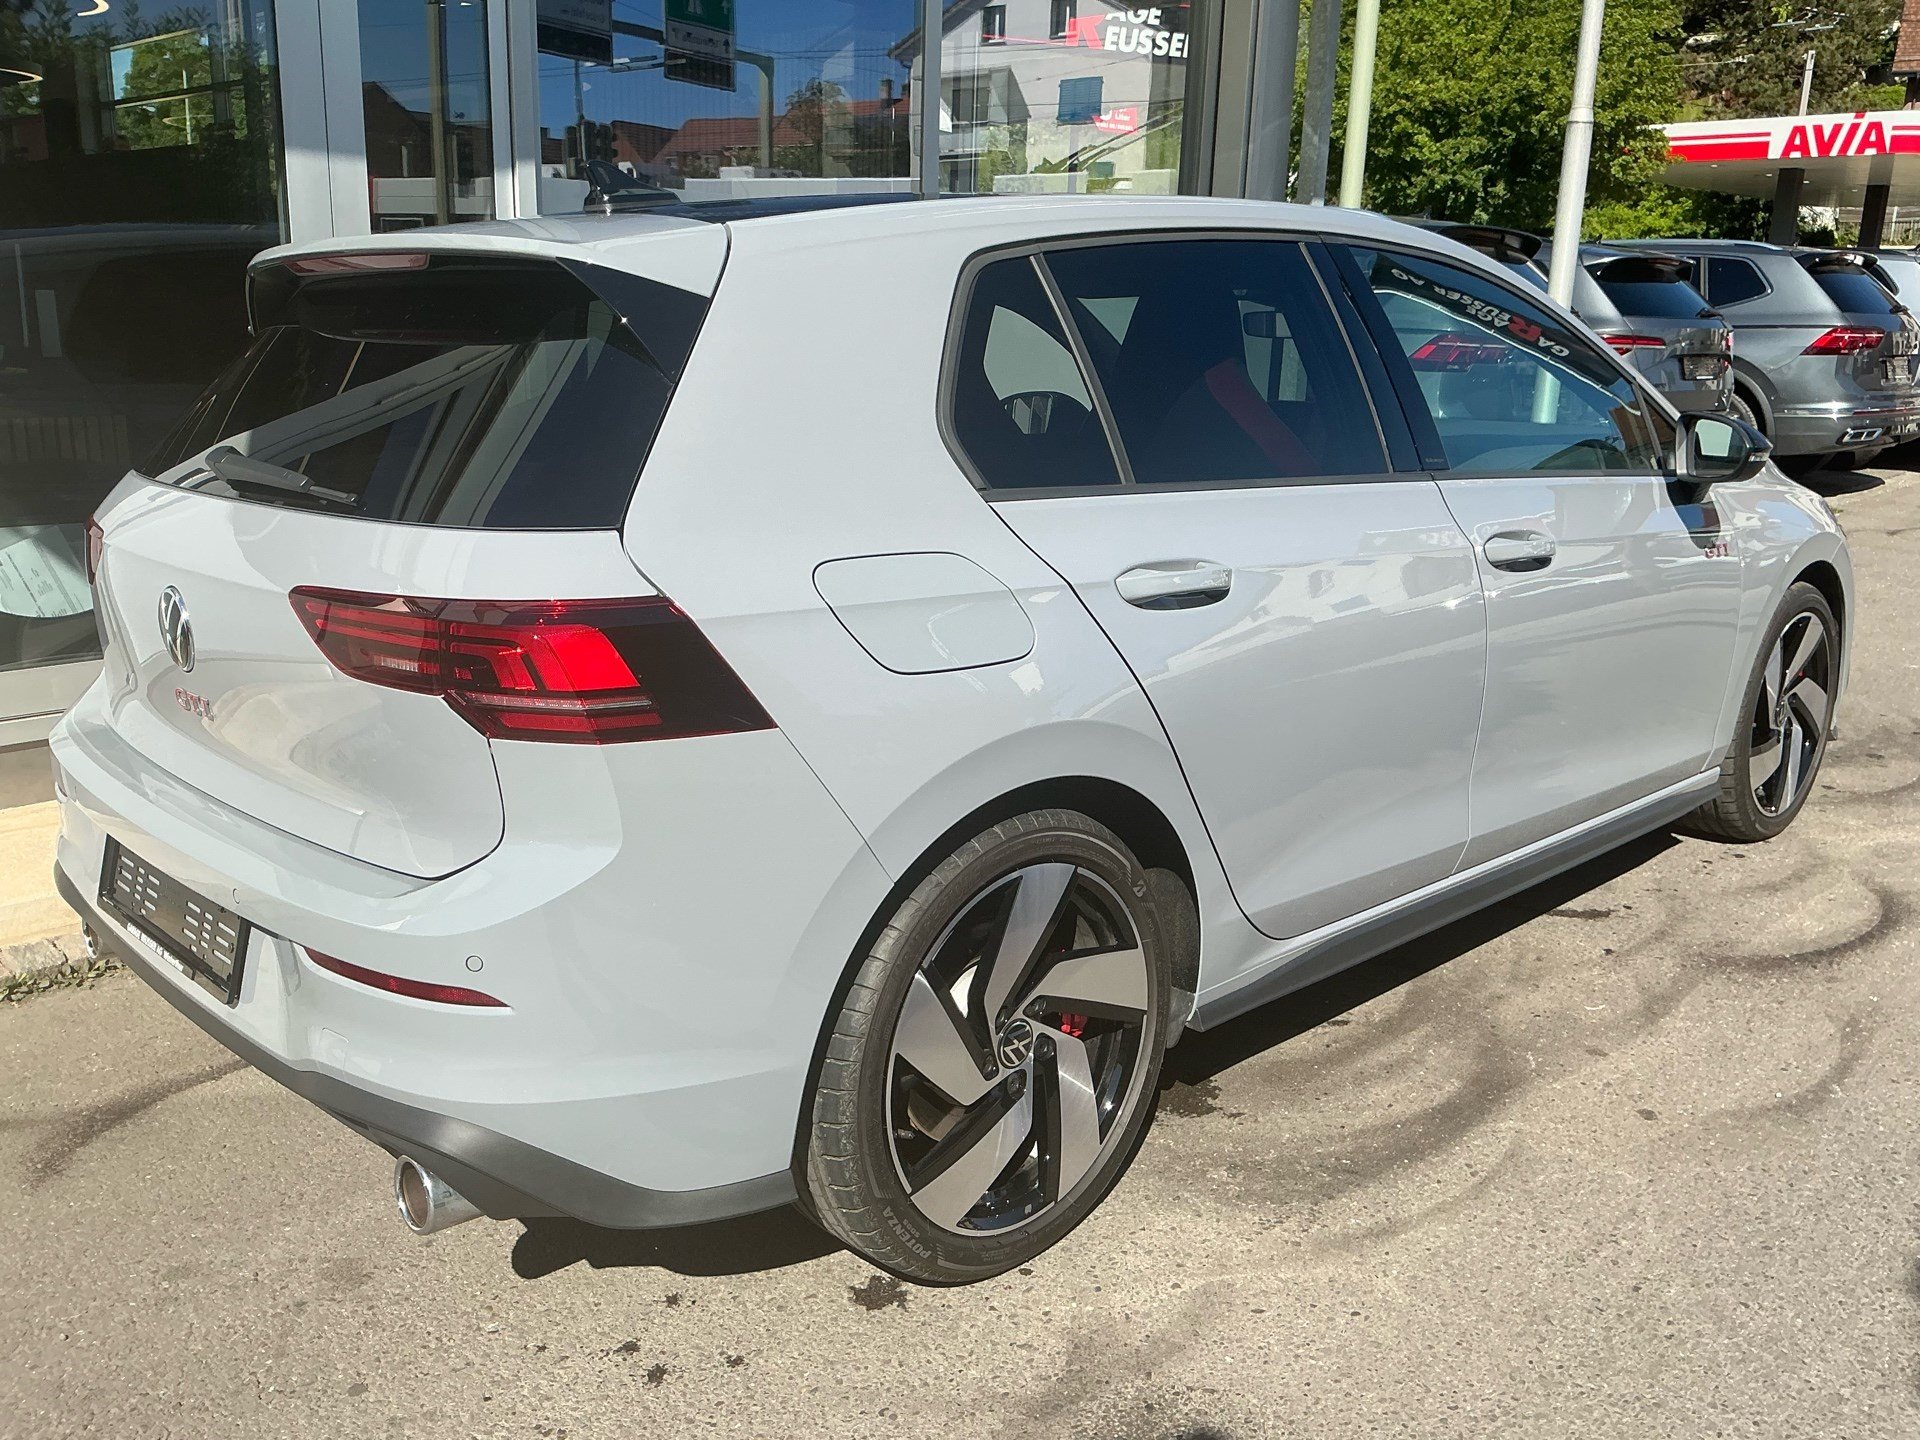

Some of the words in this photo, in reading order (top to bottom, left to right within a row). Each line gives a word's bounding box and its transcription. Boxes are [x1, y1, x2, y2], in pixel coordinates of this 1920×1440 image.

[1780, 112, 1887, 158] AVIA
[1391, 268, 1425, 286] AG
[175, 687, 215, 722] GTI
[883, 1206, 932, 1258] POTENZA
